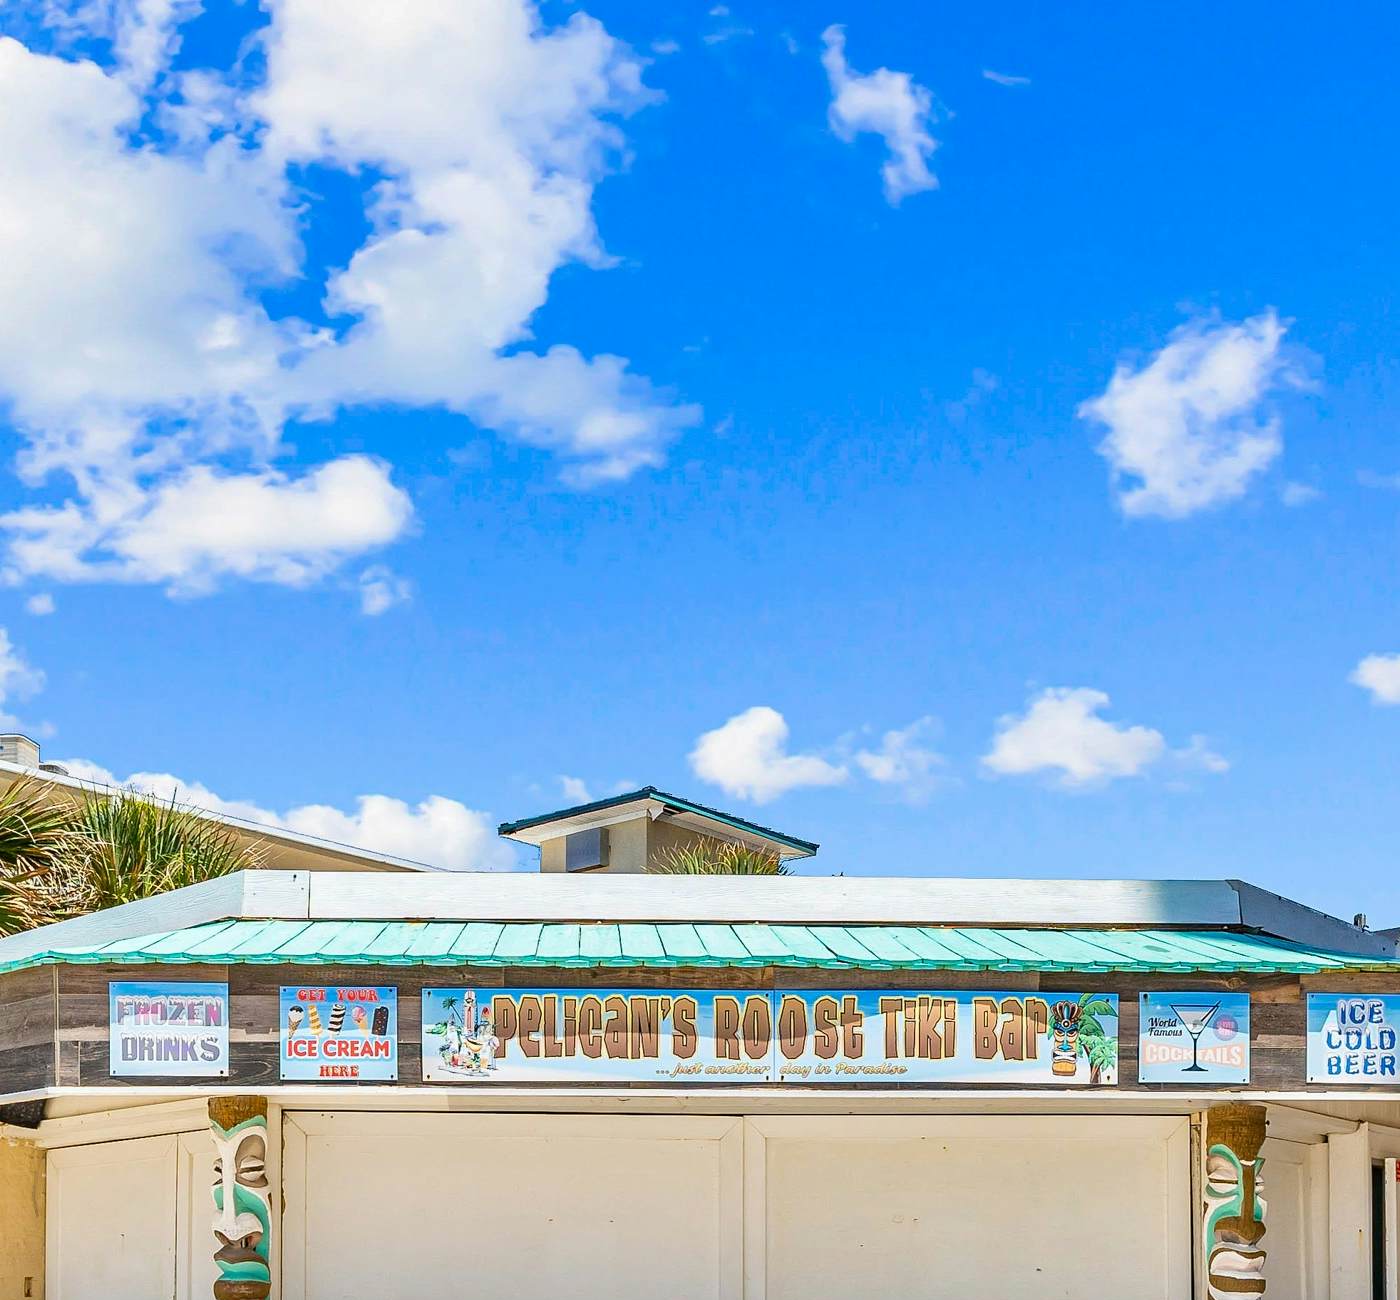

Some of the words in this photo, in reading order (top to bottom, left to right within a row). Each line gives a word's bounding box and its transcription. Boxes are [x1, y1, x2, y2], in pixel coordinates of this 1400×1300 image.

[297, 989, 325, 1001] GET
[337, 989, 378, 1001] YOUR
[117, 997, 223, 1027] FROZEN
[1340, 1001, 1384, 1024] ICE
[1147, 1017, 1178, 1028] World
[1148, 1027, 1183, 1037] Famous
[120, 1033, 220, 1062] DRINKS
[287, 1040, 316, 1057] ICE
[323, 1040, 390, 1057] CREAM
[1327, 1028, 1396, 1050] COLD
[1145, 1045, 1243, 1065] COCKTAILS
[319, 1065, 360, 1077] HERE
[704, 1062, 771, 1076] another
[779, 1064, 812, 1081] day
[815, 1064, 831, 1076] in
[835, 1063, 908, 1077] Paradise
[1327, 1053, 1396, 1077] BEER
